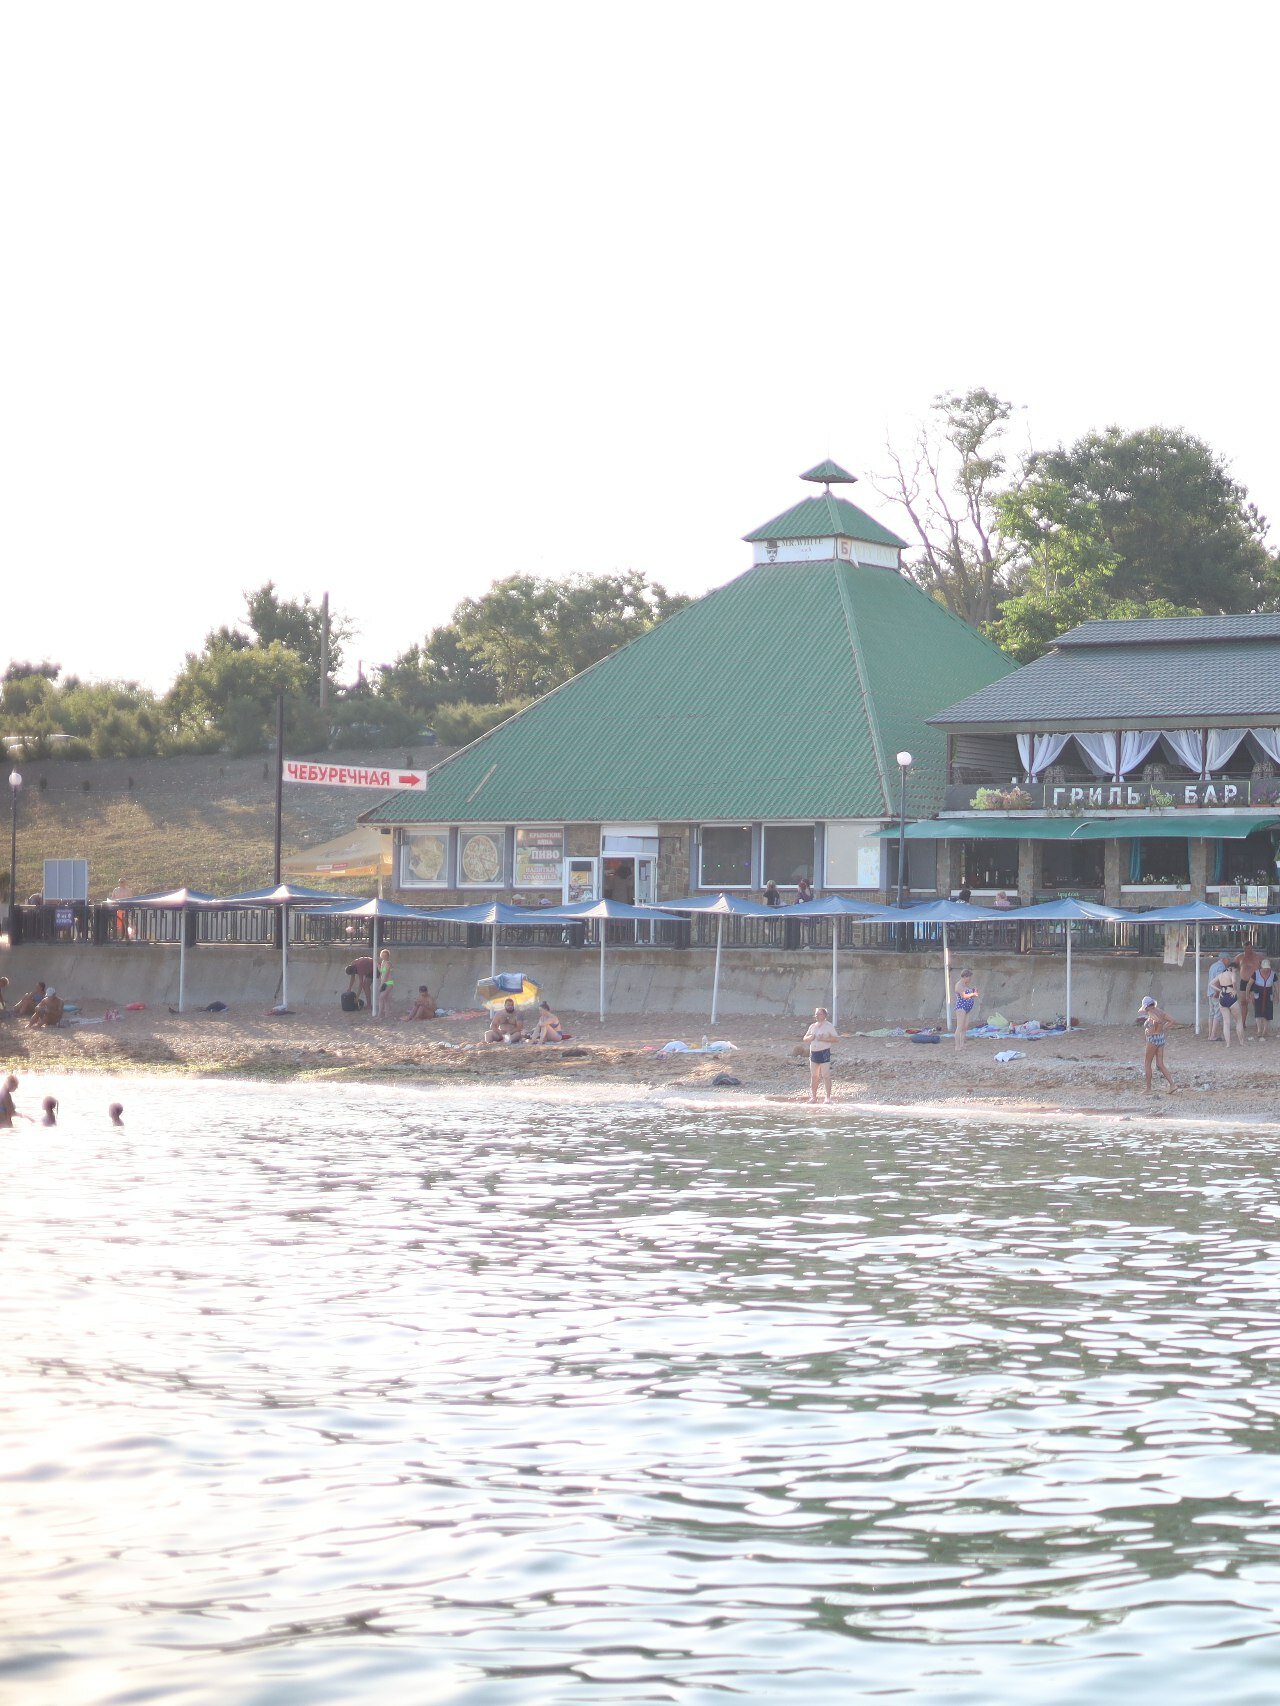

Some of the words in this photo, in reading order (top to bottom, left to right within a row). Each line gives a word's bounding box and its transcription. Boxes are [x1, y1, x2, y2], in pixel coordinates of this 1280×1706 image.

[287, 763, 390, 786] ЧЕБУРЕЧНАЯ
[1053, 786, 1141, 806] ГРИЛЬ
[1184, 784, 1238, 804] БАР
[531, 849, 560, 860] ПИВО
